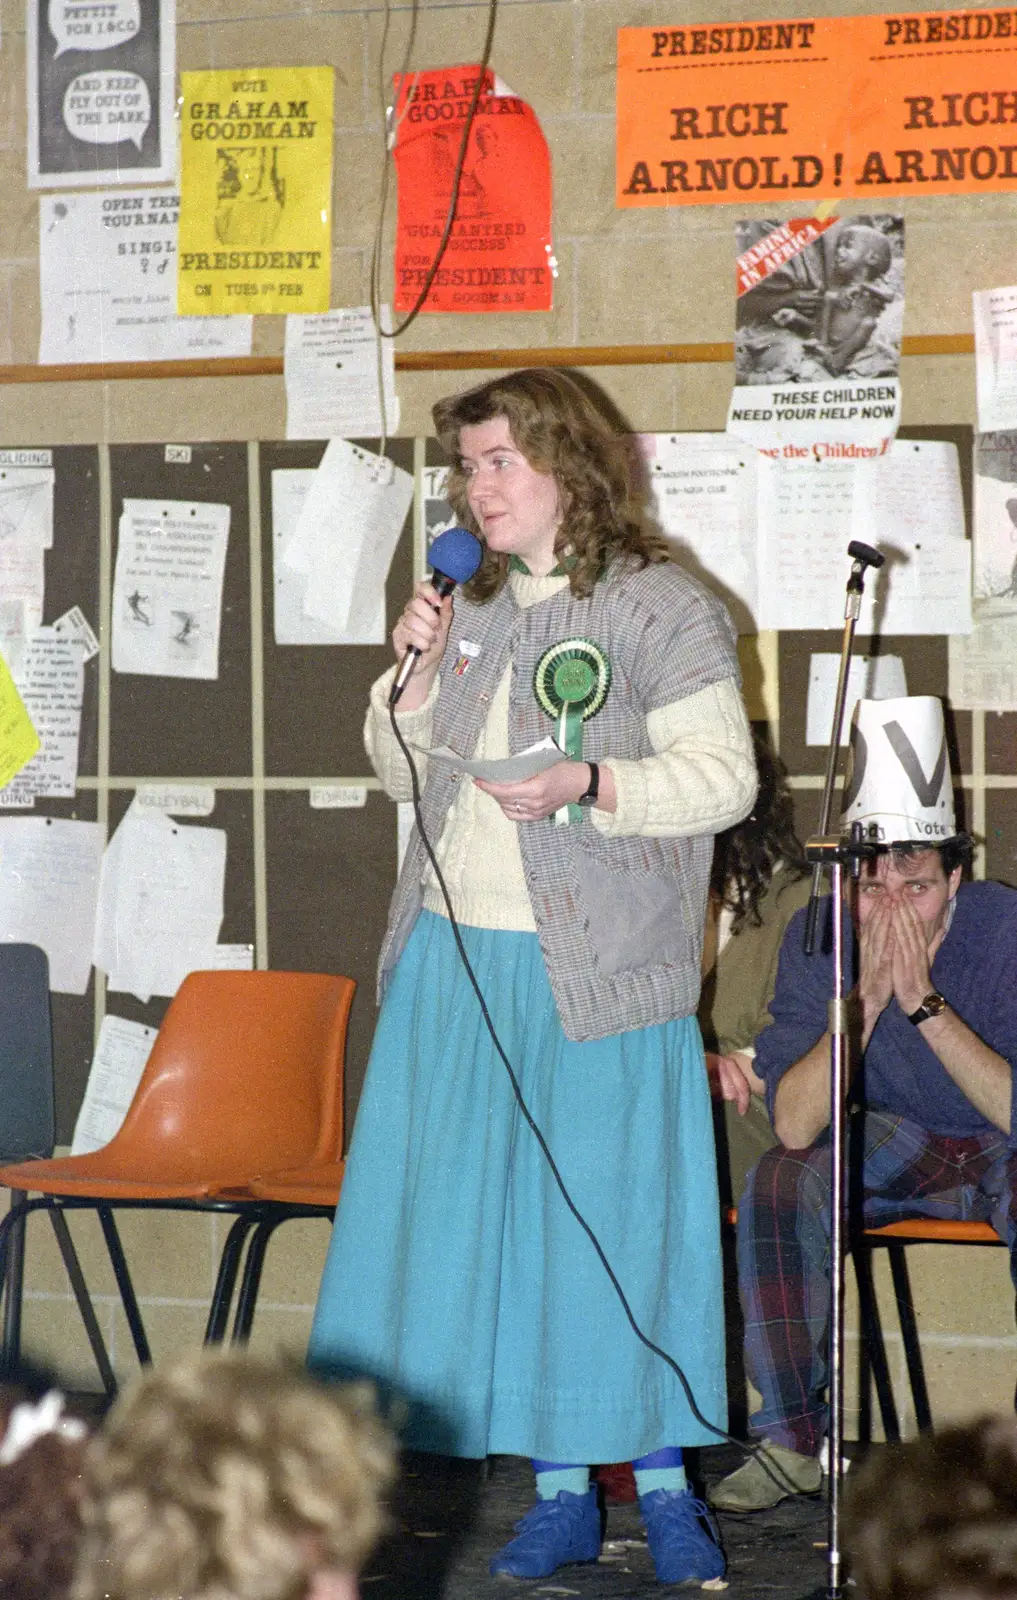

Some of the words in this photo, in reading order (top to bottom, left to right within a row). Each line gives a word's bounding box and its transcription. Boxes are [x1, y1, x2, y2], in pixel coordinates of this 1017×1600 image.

[66, 23, 92, 36] FOR
[884, 11, 1017, 46] PRESIDE
[651, 23, 816, 58] PRESIDENT
[74, 80, 102, 91] AND
[106, 77, 140, 90] KEEP
[232, 80, 268, 92] VOTE
[95, 95, 121, 107] OUT
[123, 94, 141, 105] OF
[76, 112, 102, 125] THE
[190, 101, 309, 120] GRAHAM
[190, 121, 317, 140] GOODMAN
[670, 102, 789, 141] RICH
[102, 198, 144, 212] OPEN
[118, 240, 176, 255] SINGL
[736, 221, 796, 272] FAMINE
[179, 252, 322, 271] PRESIDENT
[740, 268, 765, 291] IN
[763, 224, 821, 271] AFRICA
[194, 284, 213, 297] ON
[224, 283, 259, 297] TUES
[278, 284, 303, 297] FEB
[771, 391, 820, 405] THESE
[822, 386, 897, 404] CHILDREN
[731, 409, 774, 422] NEED
[775, 407, 816, 421] YOUR
[818, 405, 859, 420] HELP
[860, 404, 897, 419] NOW
[168, 451, 189, 462] SKI
[783, 443, 810, 459] the
[812, 441, 879, 459] Children
